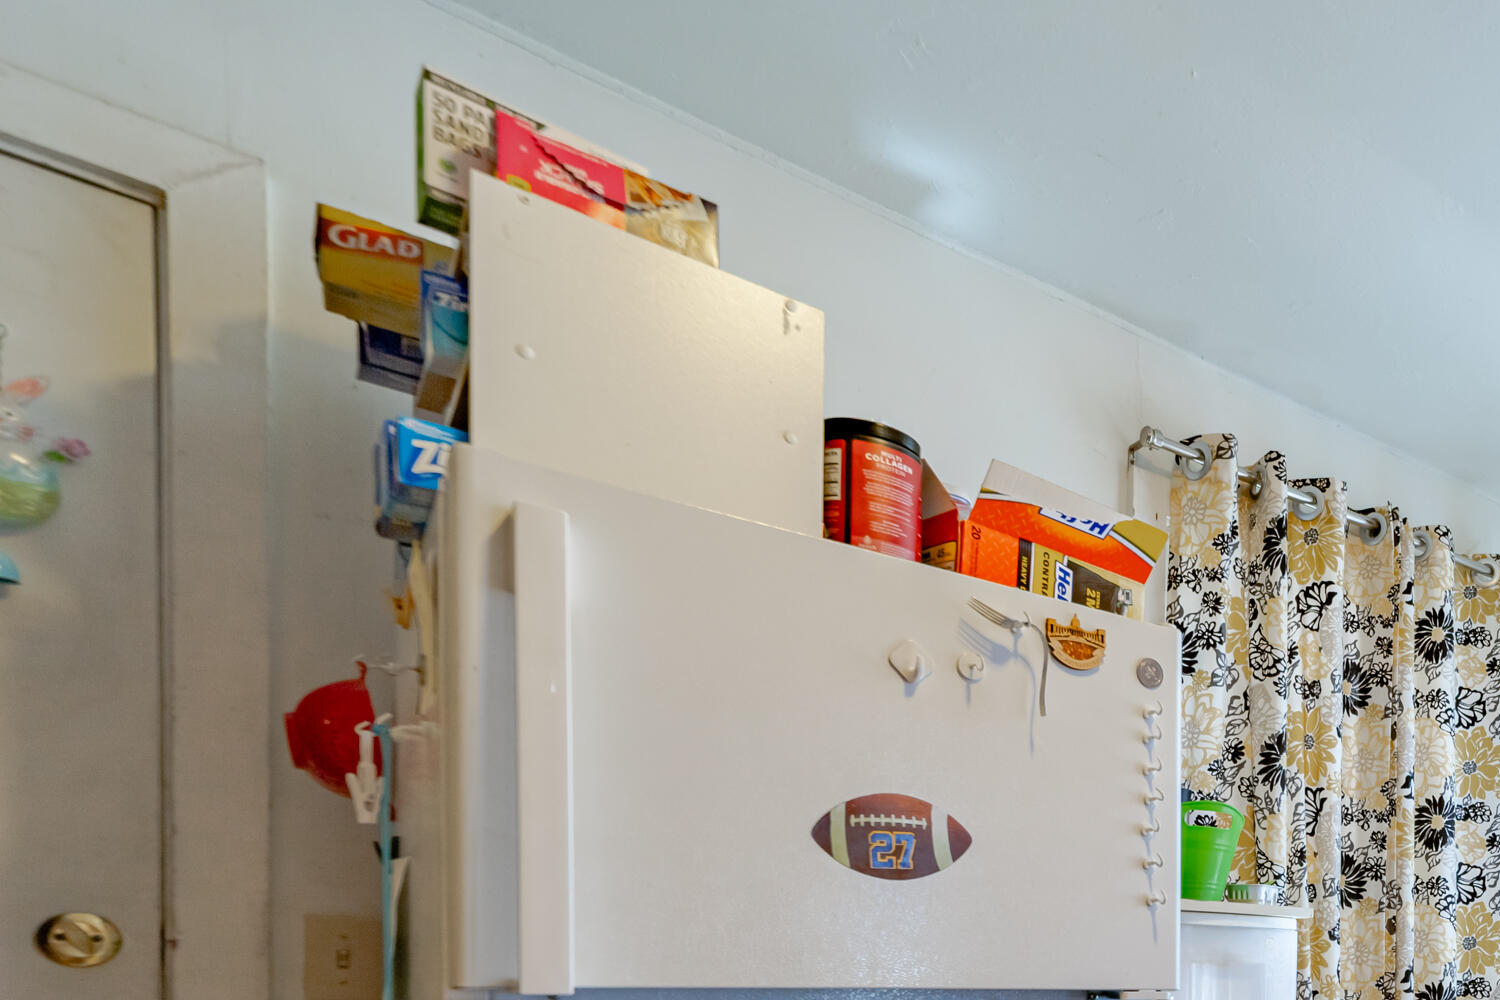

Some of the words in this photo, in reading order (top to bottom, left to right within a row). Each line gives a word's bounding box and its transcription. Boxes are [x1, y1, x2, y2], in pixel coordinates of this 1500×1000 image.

[328, 224, 421, 258] GLAD
[865, 452, 912, 475] COLLAGEN
[971, 525, 982, 540] 20
[1020, 555, 1028, 585] HEAVY
[868, 830, 916, 870] 27
